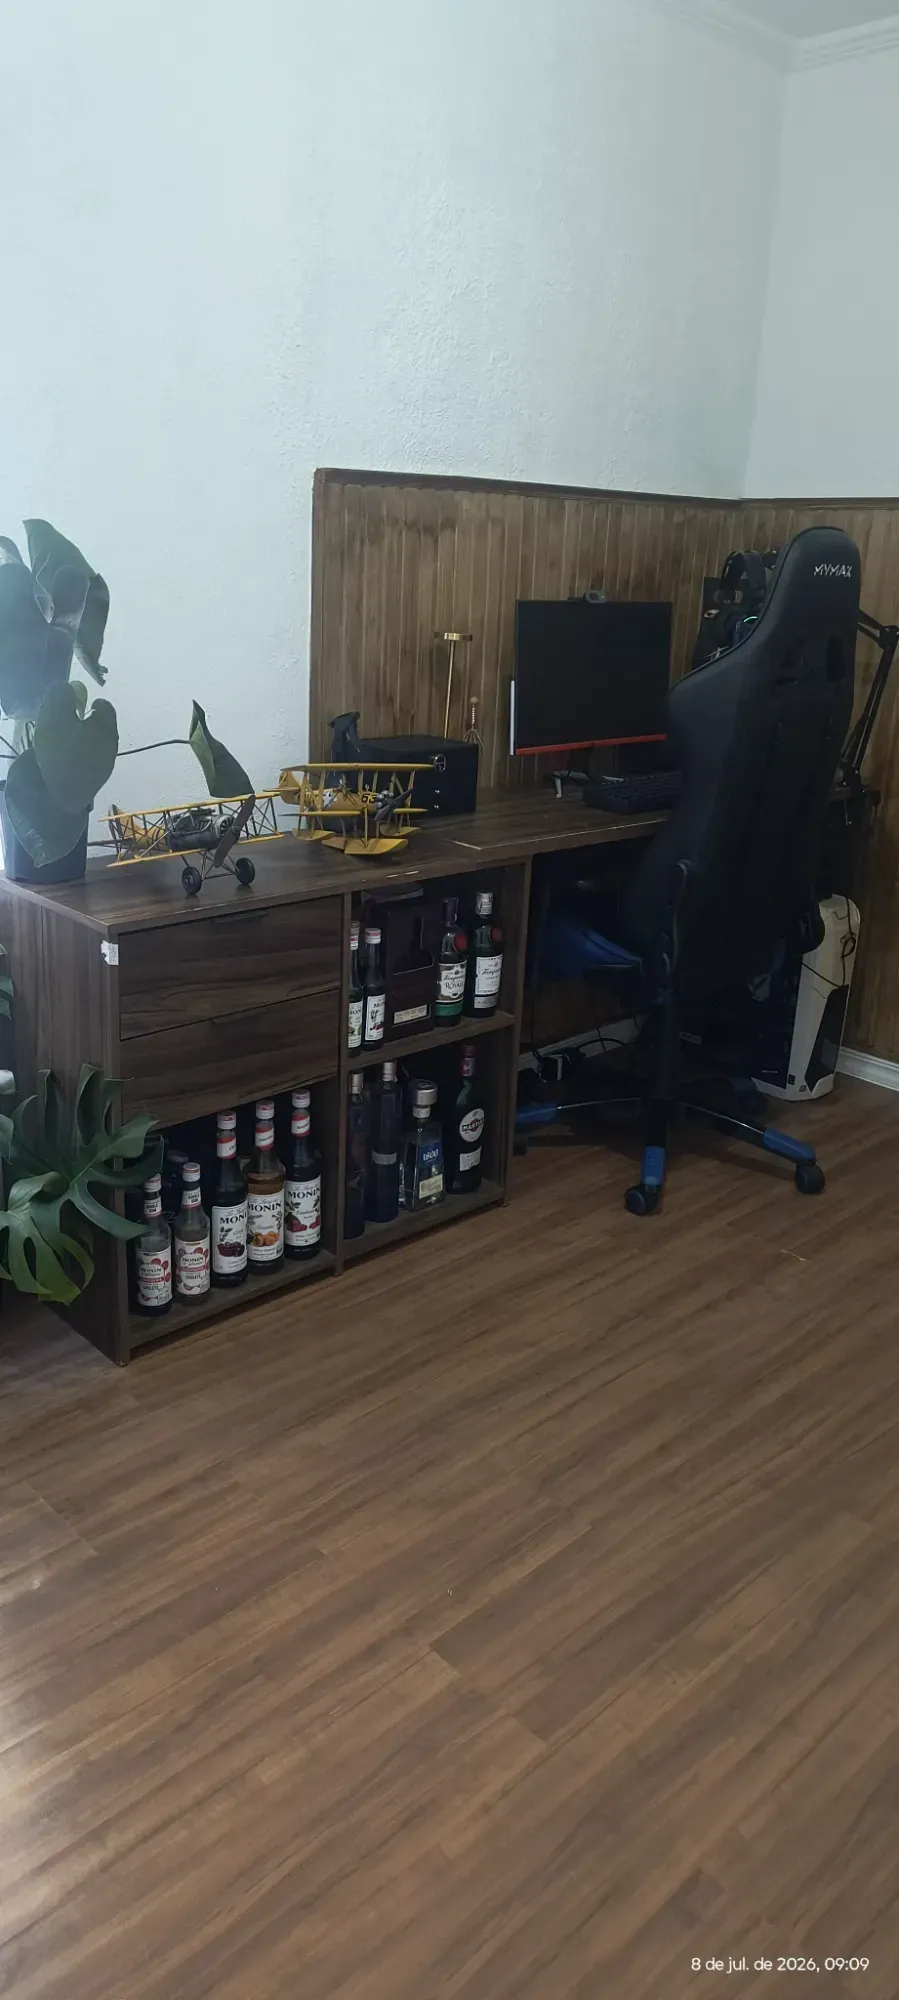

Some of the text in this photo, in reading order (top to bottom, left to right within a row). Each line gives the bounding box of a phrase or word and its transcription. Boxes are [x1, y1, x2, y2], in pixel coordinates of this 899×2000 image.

[813, 563, 853, 578] MYMAX
[423, 1149, 439, 1161] 1800
[220, 1211, 247, 1224] MONI
